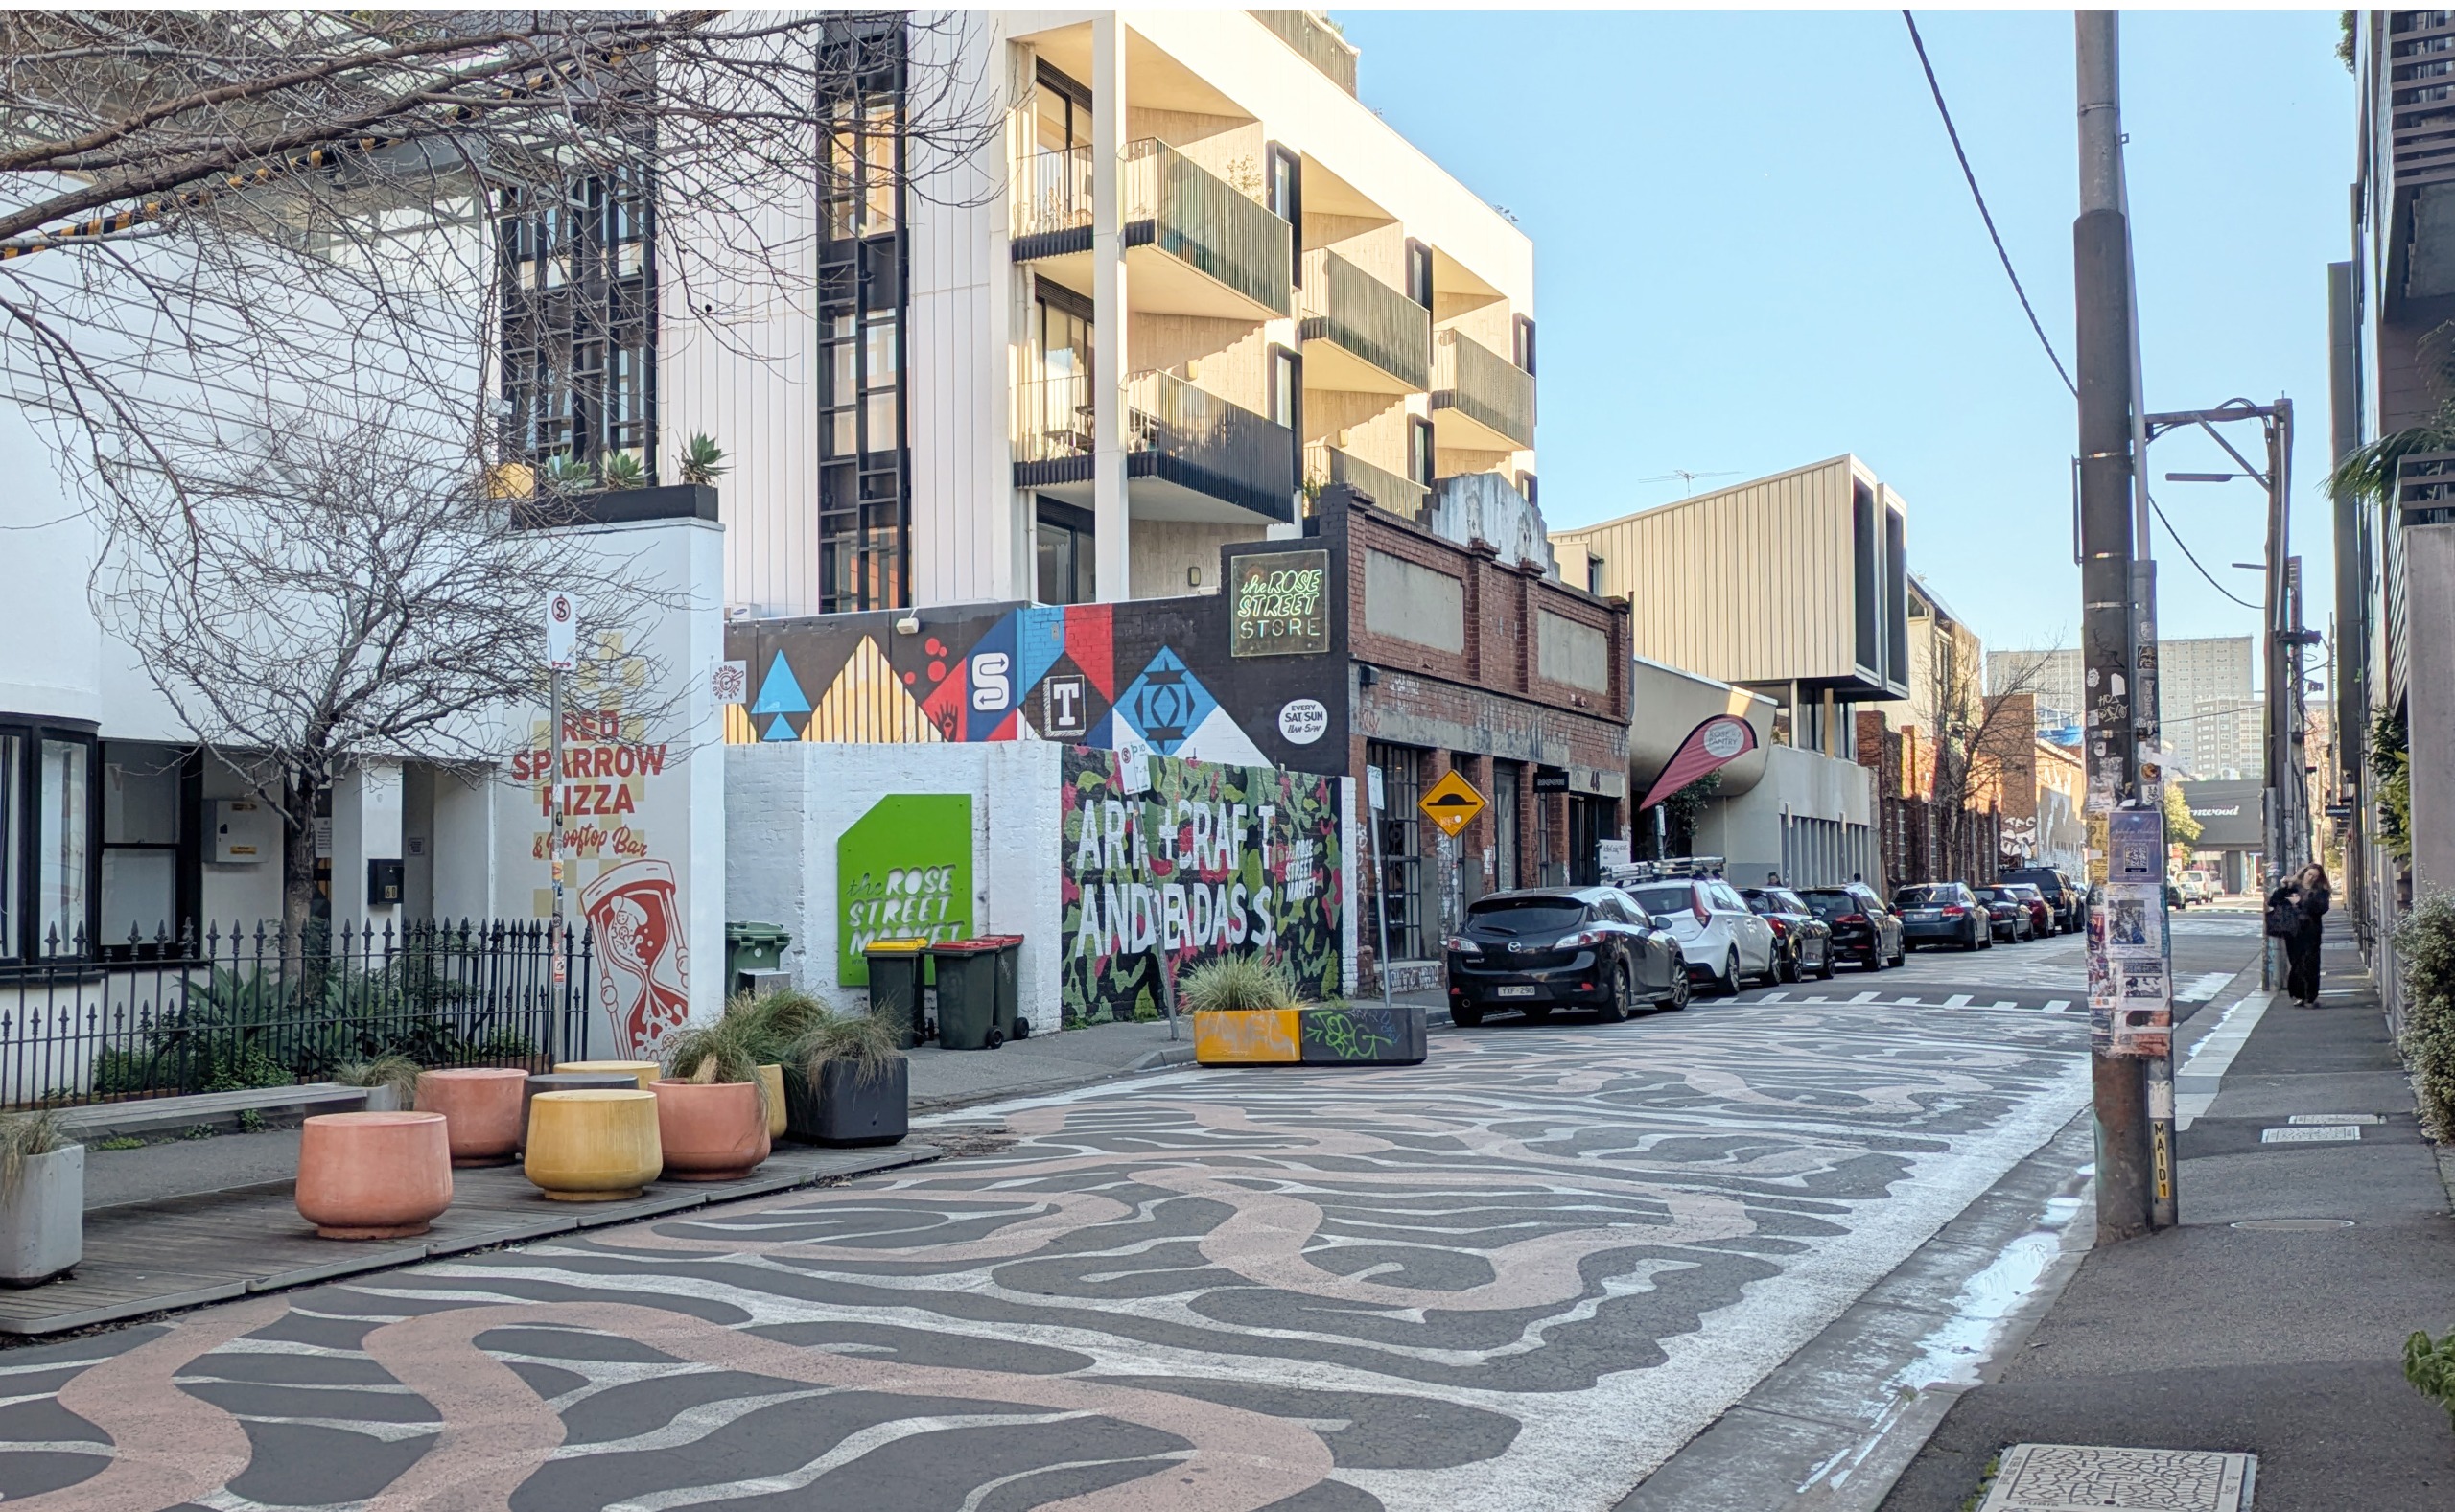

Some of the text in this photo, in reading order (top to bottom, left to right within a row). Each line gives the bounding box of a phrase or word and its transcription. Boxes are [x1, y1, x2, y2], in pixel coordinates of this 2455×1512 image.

[1240, 569, 1322, 594] the ROSE
[1237, 592, 1320, 617] STREET
[1240, 617, 1321, 639] STORE
[561, 710, 620, 742] RED
[612, 824, 648, 858] Bar
[1075, 799, 1146, 870] ART
[846, 863, 957, 897] the ROSE
[1285, 857, 1314, 882] STREET
[386, 886, 396, 898] 60
[1286, 877, 1317, 903] MARKET
[849, 893, 953, 927] STREET
